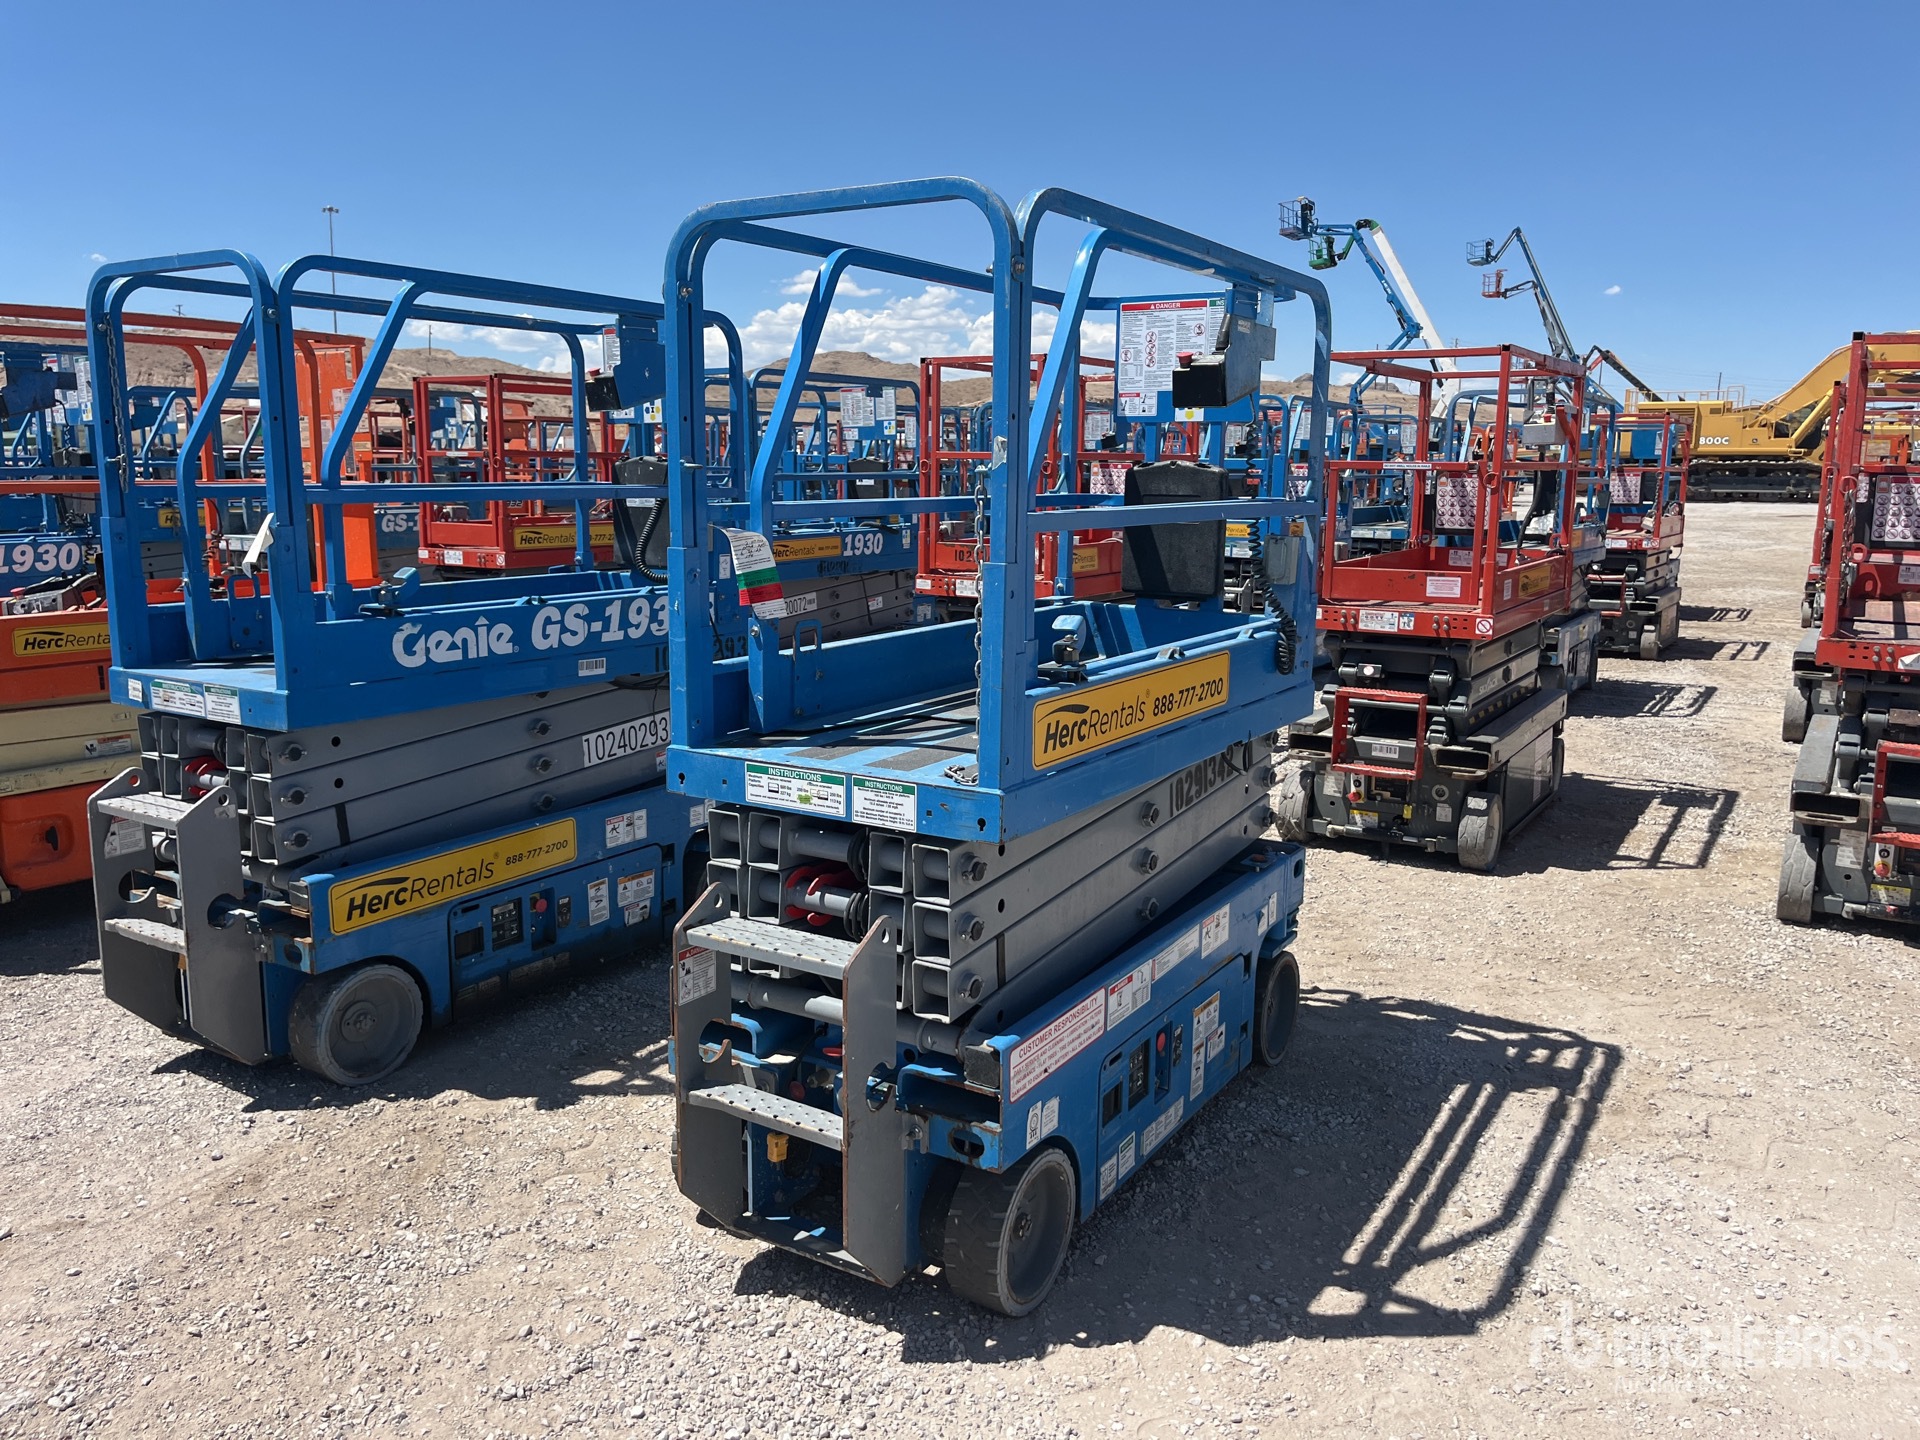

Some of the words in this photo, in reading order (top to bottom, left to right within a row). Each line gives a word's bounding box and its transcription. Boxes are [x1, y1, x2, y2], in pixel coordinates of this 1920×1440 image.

[1699, 436, 1729, 444] 800C
[520, 533, 575, 545] HercRentals
[843, 533, 884, 557] 1930
[392, 616, 514, 668] Genie
[1043, 695, 1145, 754] HercRentals
[1153, 677, 1224, 717] 888-777-2700
[584, 716, 669, 765] 10240293
[768, 767, 822, 782] INSTRUCTIONS
[865, 780, 903, 793] INSTRUCTIONS
[345, 857, 495, 922] HercRentals
[505, 839, 568, 866] 888-777-2700
[1018, 1028, 1051, 1059] CUSTOMER
[1053, 995, 1097, 1035] RESPONSIBILITY
